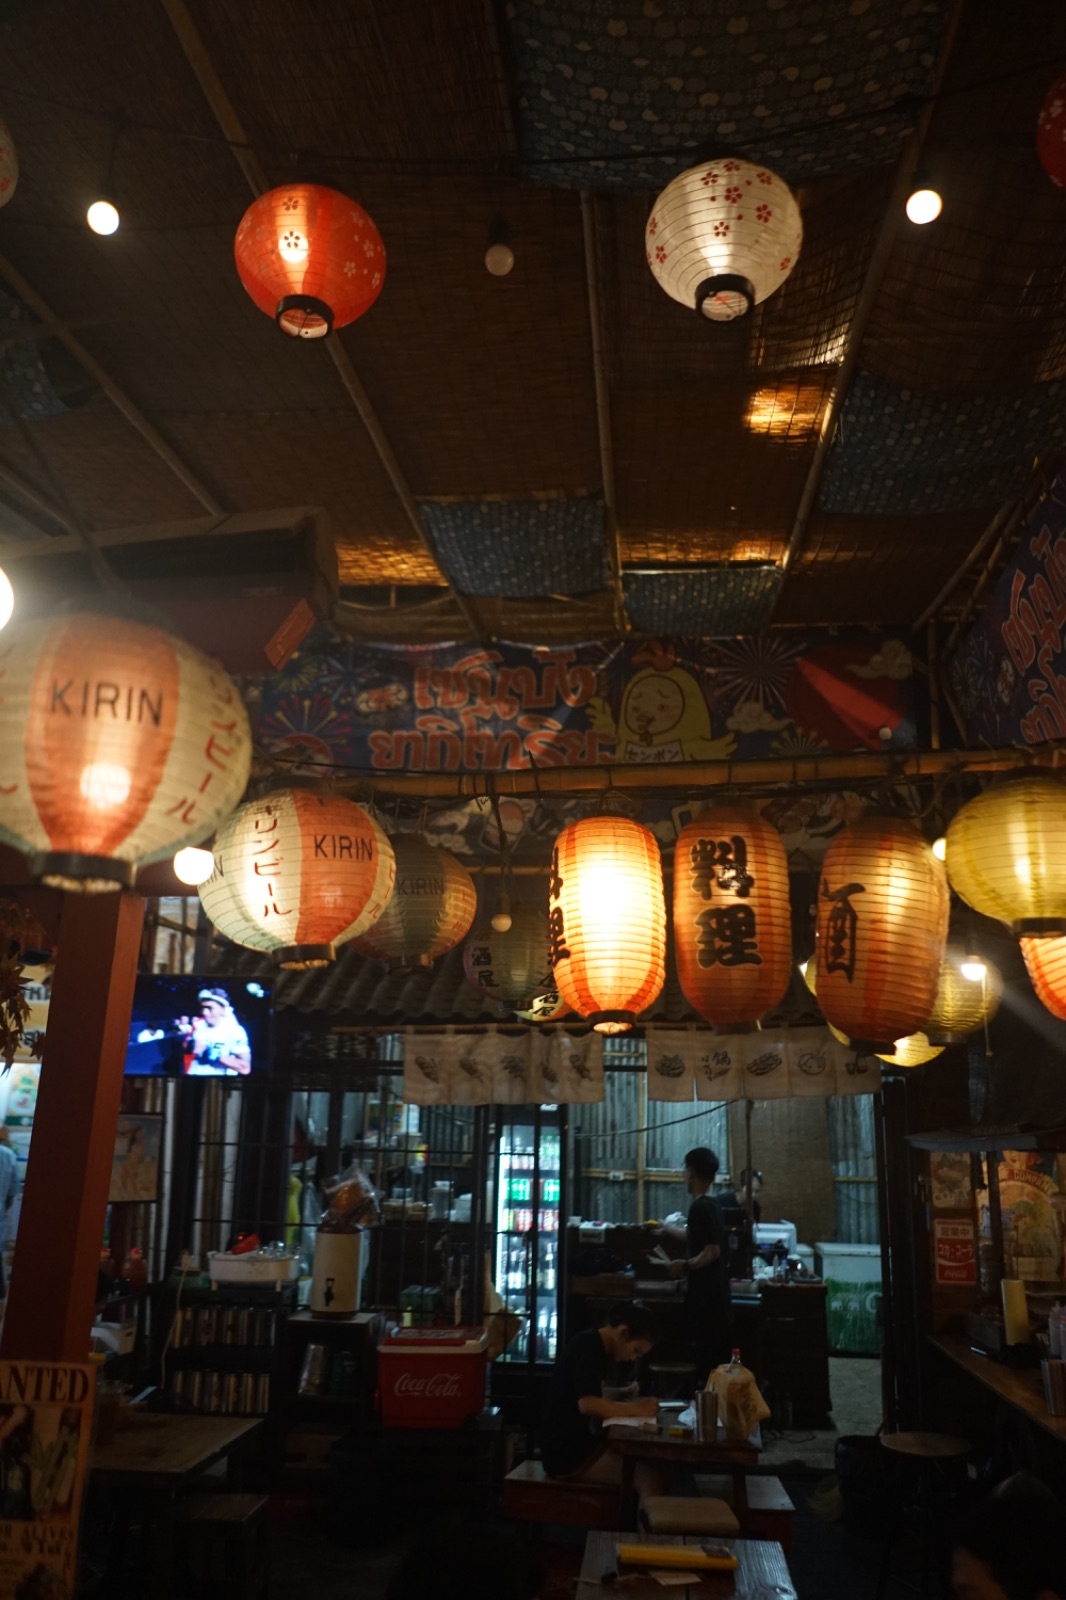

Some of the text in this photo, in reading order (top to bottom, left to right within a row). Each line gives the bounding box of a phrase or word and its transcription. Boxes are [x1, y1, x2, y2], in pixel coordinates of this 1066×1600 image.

[51, 680, 163, 728] KIRIN
[314, 835, 373, 861] KIRIN
[398, 877, 445, 896] KIRIN
[689, 836, 763, 969] 料理
[0, 1366, 90, 1404] NTED
